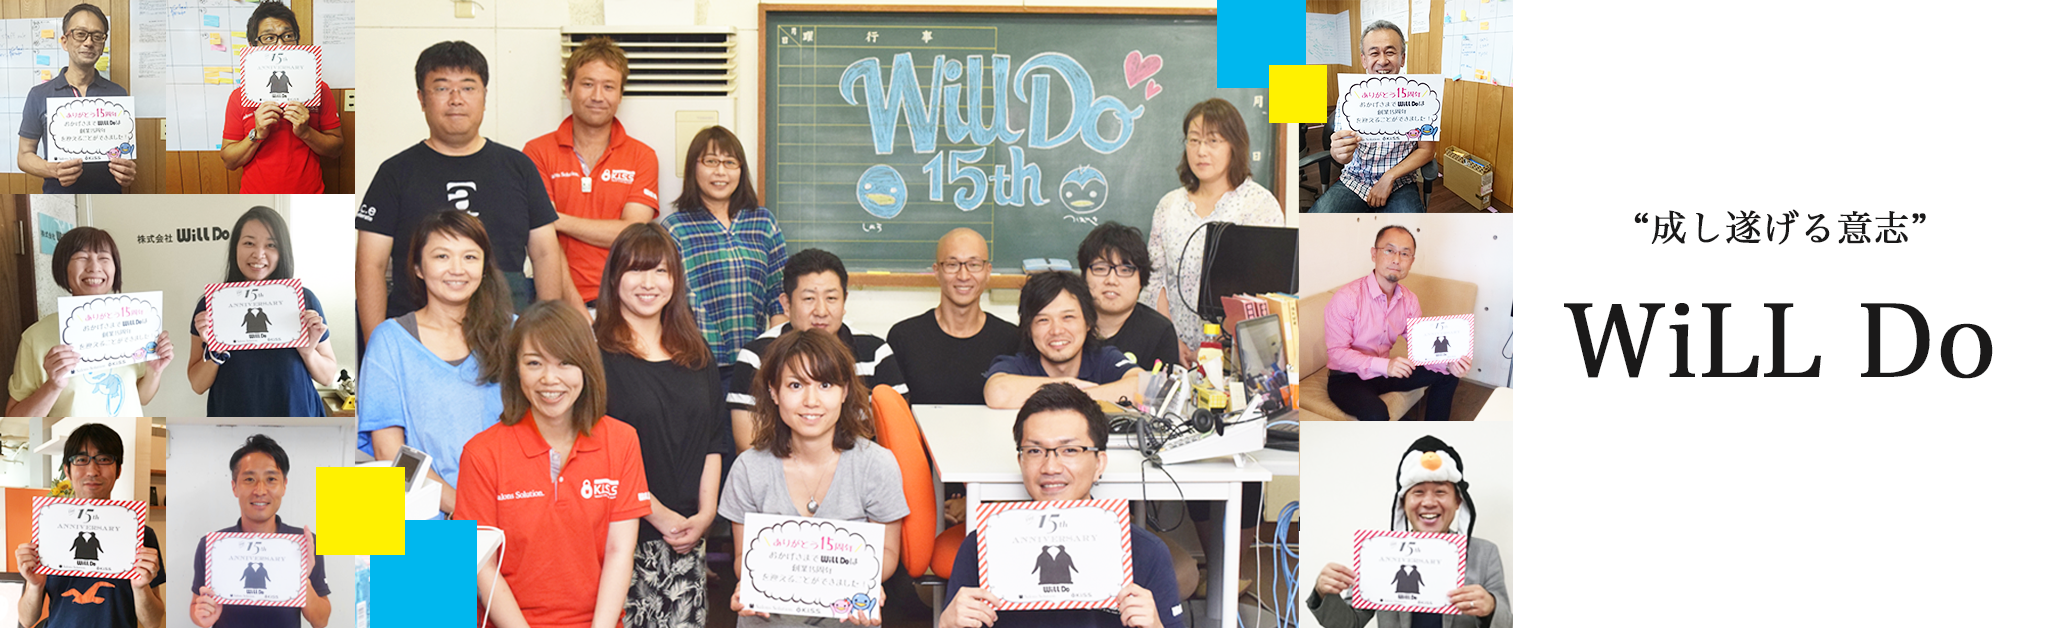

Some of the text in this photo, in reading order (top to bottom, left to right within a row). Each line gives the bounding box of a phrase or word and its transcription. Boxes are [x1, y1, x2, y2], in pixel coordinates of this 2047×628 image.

[865, 30, 934, 44] 行 事
[839, 52, 1144, 155] Will Do
[1253, 95, 1263, 108] 月
[922, 146, 1050, 211] 15th
[137, 226, 230, 244] 株式会社 Will Do
[57, 523, 120, 532] ANNIVERSARY
